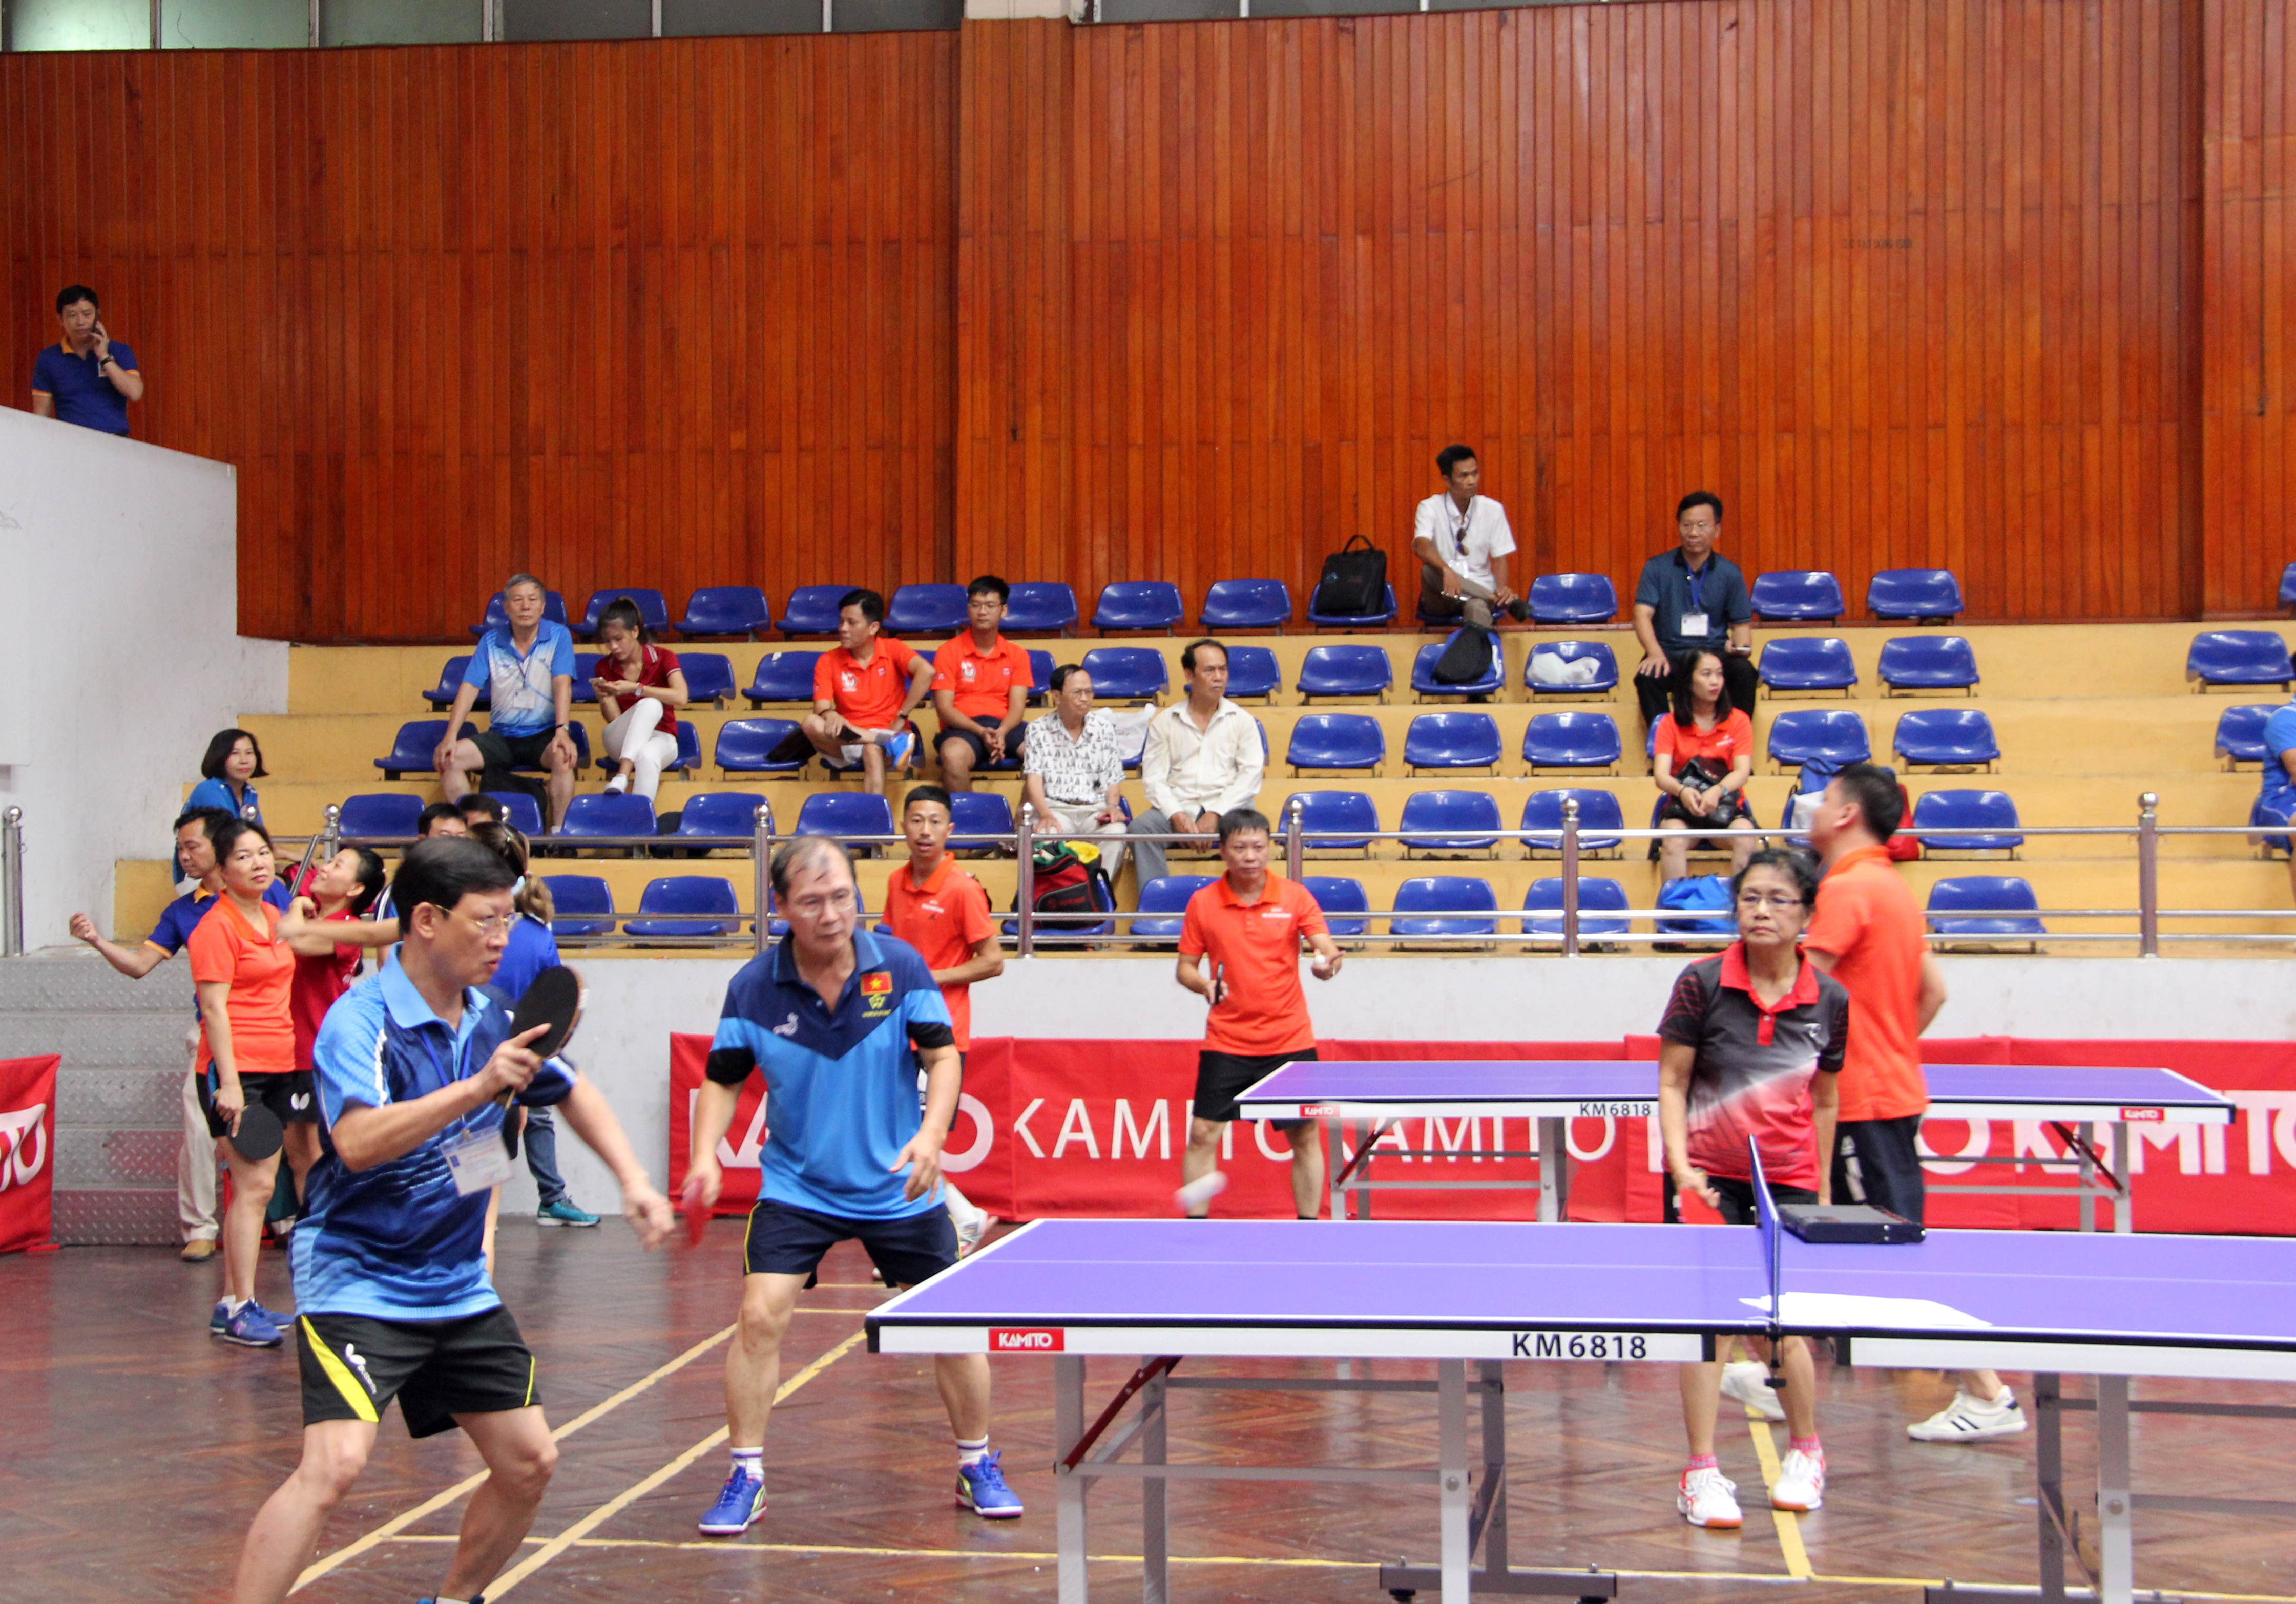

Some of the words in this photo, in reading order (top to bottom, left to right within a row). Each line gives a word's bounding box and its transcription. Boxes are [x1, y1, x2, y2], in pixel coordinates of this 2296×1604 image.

[1580, 1103, 1651, 1116] KM6818
[998, 1333, 1052, 1348] KAMITO
[1512, 1333, 1646, 1358] KM6818
